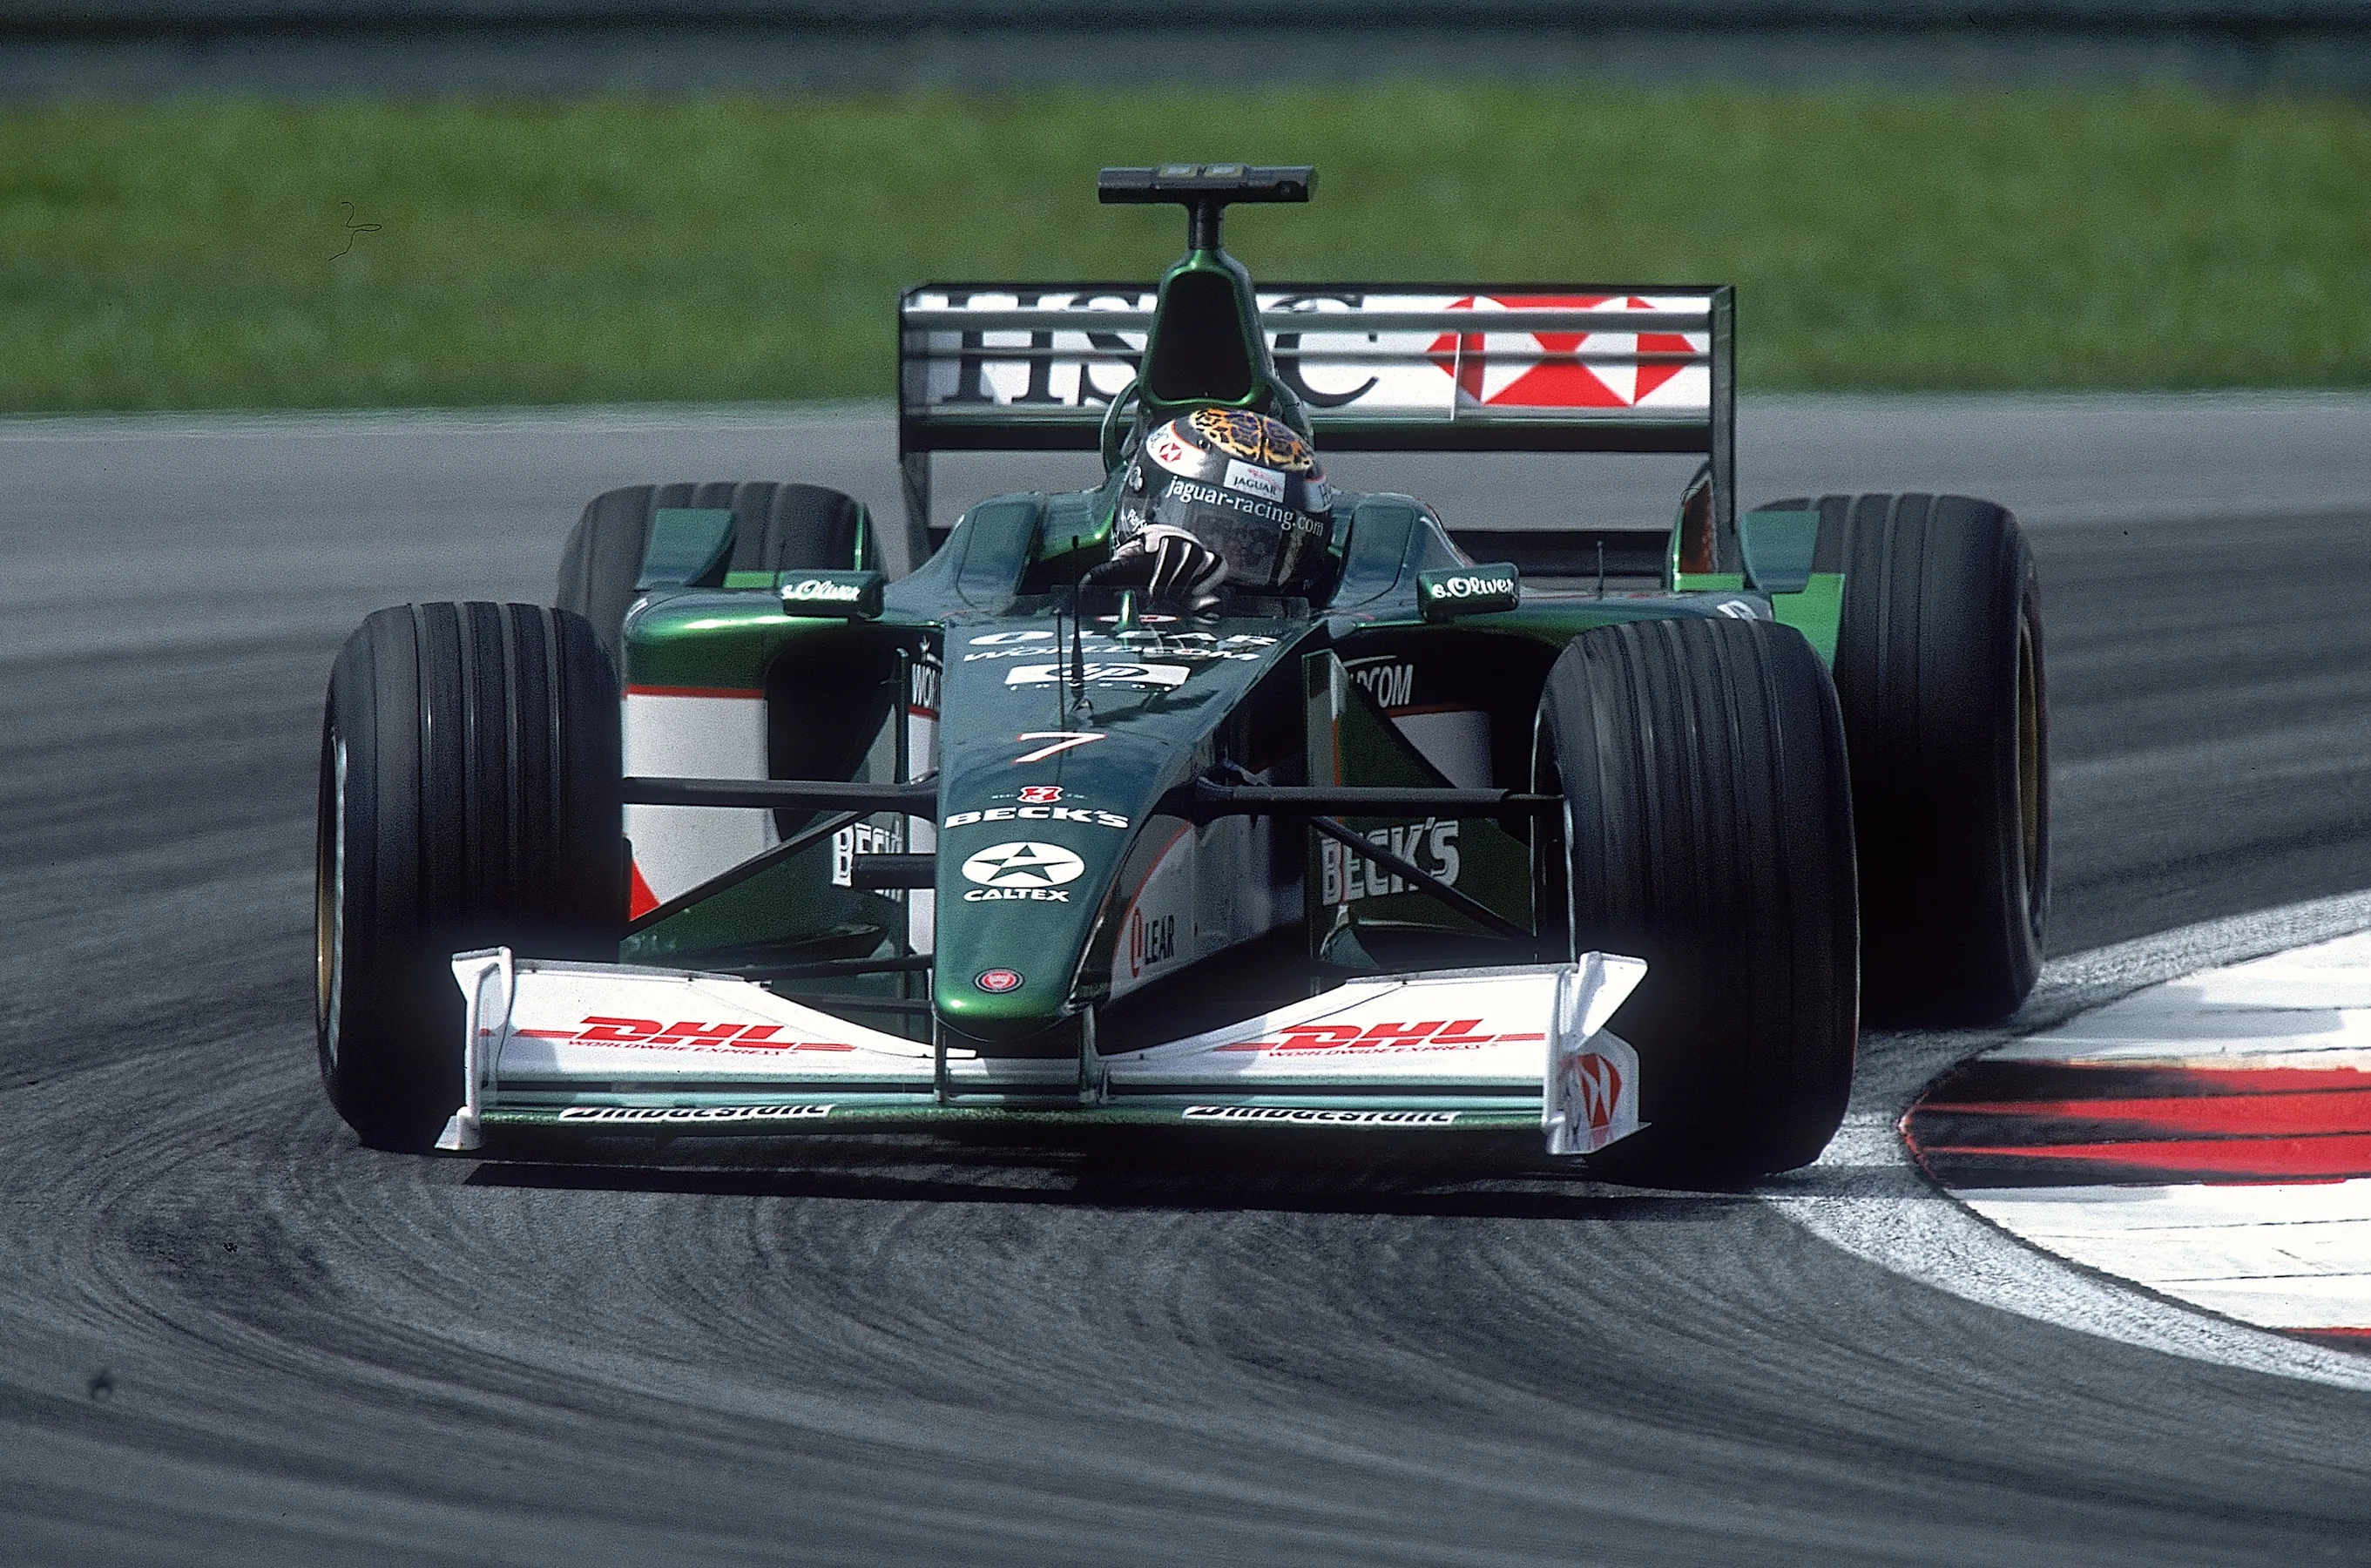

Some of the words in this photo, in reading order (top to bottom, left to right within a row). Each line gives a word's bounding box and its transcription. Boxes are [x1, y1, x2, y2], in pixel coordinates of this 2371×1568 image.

[942, 293, 1380, 407] HSC
[1233, 476, 1277, 497] JAGUAR
[1165, 475, 1324, 537] jaguar-racing.com
[1011, 731, 1108, 763] 7
[944, 807, 1130, 829] BECK'S
[1321, 816, 1460, 906] BECK'S
[963, 888, 1070, 902] CALTEX
[568, 1040, 690, 1051] WORLDWIDE
[575, 1016, 797, 1050] DHL
[1275, 1018, 1493, 1050] DHL
